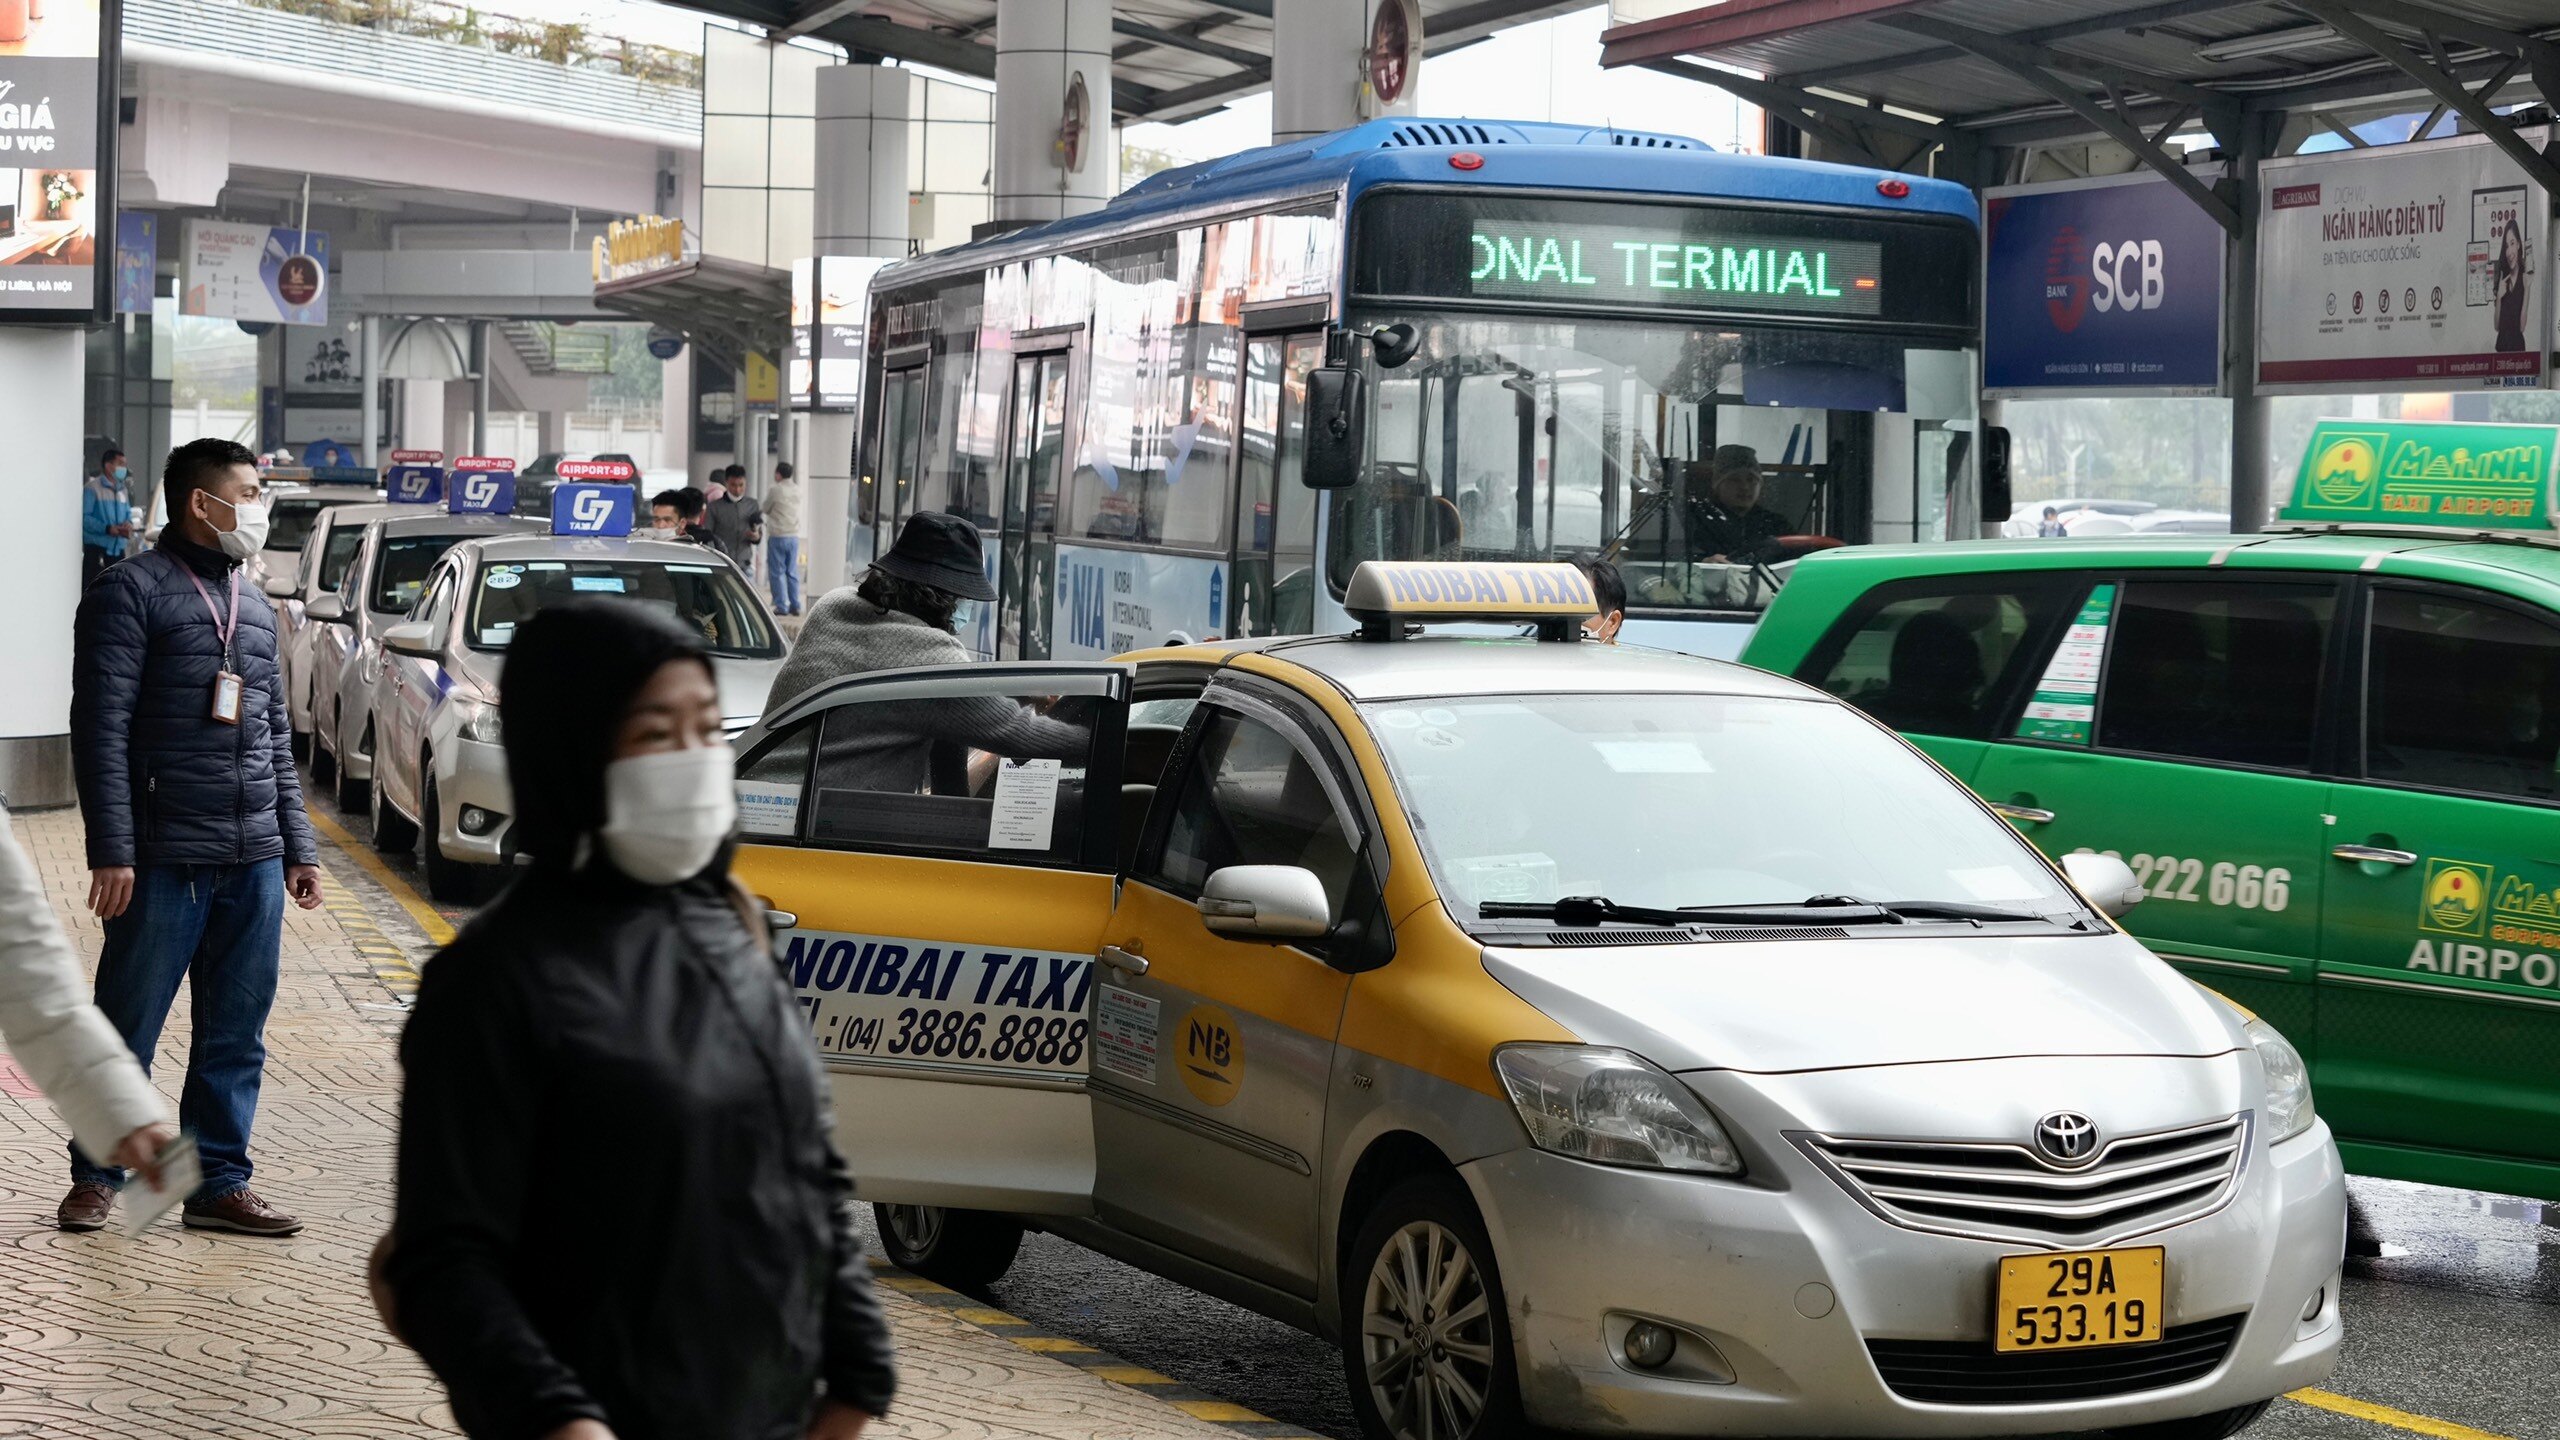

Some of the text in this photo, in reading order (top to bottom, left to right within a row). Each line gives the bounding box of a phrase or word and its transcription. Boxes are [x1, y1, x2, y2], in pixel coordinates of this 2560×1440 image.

[2282, 190, 2318, 205] AGRIBANK
[2322, 195, 2446, 243] NGÂN HÀNG ĐIỆN TỬ
[1612, 242, 1841, 297] TERMIAL
[2092, 239, 2164, 313] SCB
[2362, 249, 2378, 262] CHO
[2046, 285, 2068, 298] BANK
[401, 470, 431, 499] G7
[465, 474, 499, 508] G7
[562, 464, 629, 476] AIRPORT-BS
[573, 489, 614, 531] G7
[2381, 494, 2535, 517] TAXI AIRPORT
[1071, 563, 1105, 651] NIA
[1384, 568, 1590, 604] NOIBAI TAXI
[2130, 853, 2291, 911] 222 666
[784, 936, 1094, 1013] NOIBAI TAXI
[2406, 939, 2560, 988] AIRPO
[838, 1015, 884, 1054] (04)
[888, 1007, 1088, 1066] 3886.8888
[1188, 1017, 1231, 1067] NB
[2047, 1256, 2116, 1298] 29A
[2016, 1300, 2144, 1345] 533.19
